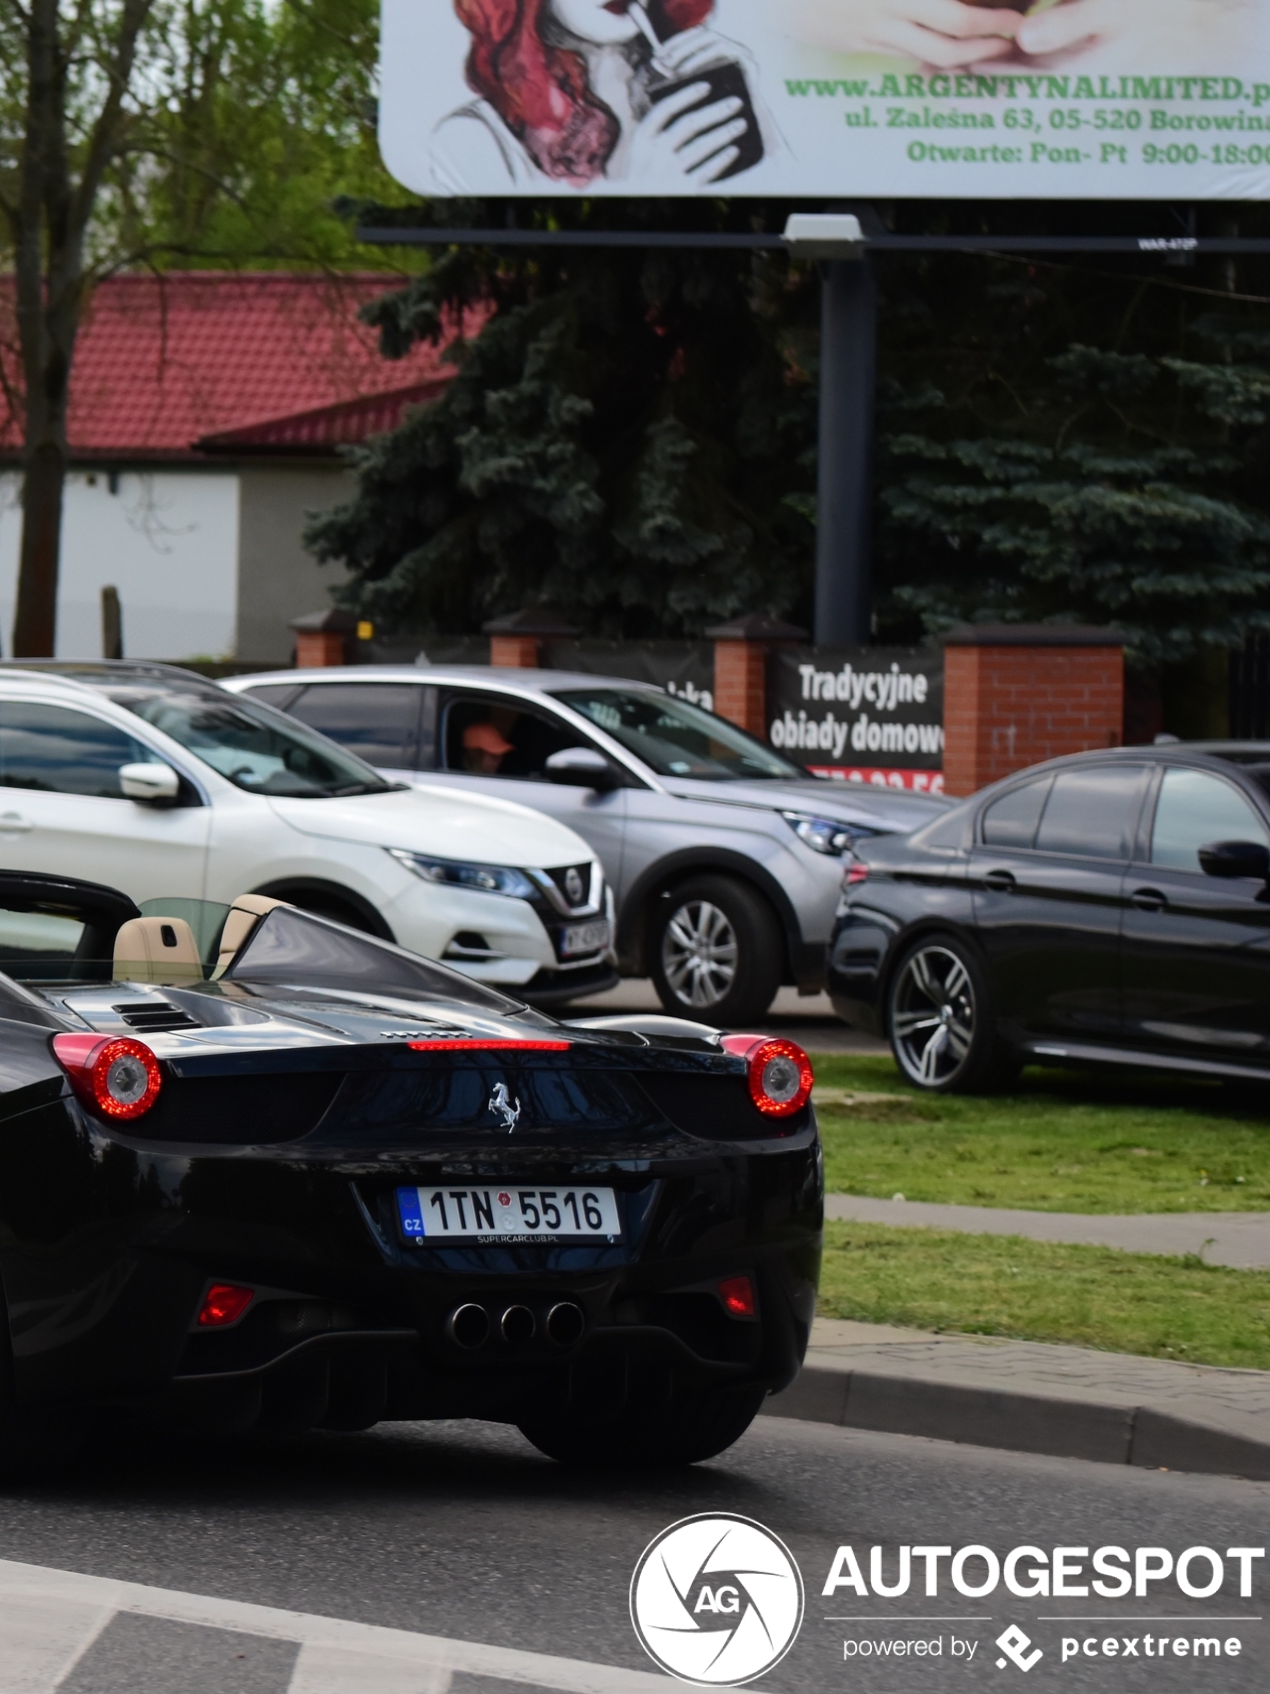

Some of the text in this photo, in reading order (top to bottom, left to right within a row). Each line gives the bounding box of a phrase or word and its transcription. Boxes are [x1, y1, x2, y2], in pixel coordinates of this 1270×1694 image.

[845, 106, 878, 128] ul.
[1003, 108, 1042, 133] 63,
[1049, 109, 1142, 130] 05-520
[907, 140, 1023, 163] Otwarte:
[1030, 142, 1092, 163] Pon-
[1100, 142, 1127, 164] Pt
[798, 662, 928, 711] Tradycyjne
[770, 710, 944, 759] obiady domow
[430, 1191, 603, 1230] 1TN 5516
[404, 1219, 422, 1231] CZ
[477, 1235, 559, 1243] SUPERCARCLUB.PL
